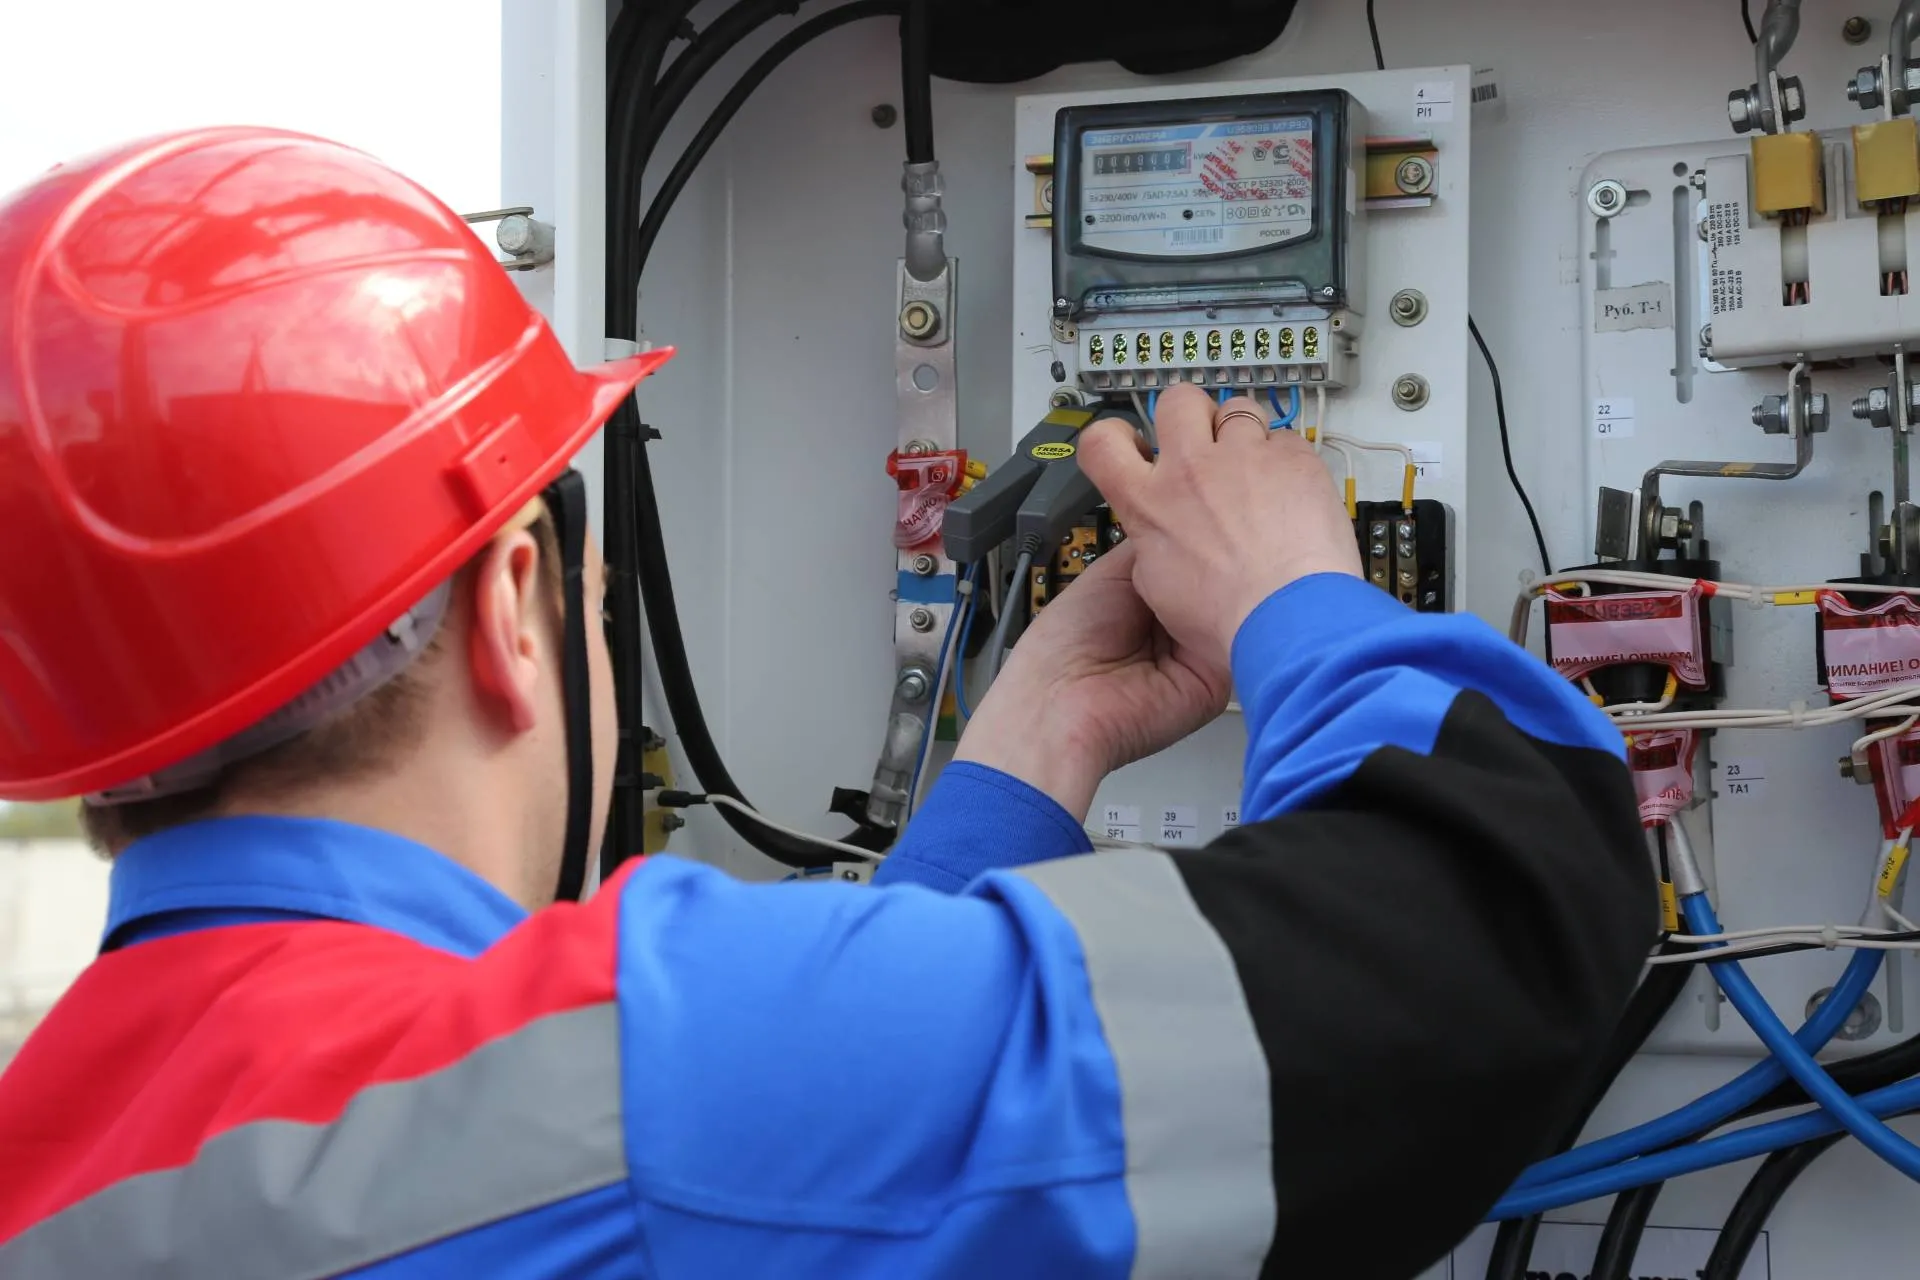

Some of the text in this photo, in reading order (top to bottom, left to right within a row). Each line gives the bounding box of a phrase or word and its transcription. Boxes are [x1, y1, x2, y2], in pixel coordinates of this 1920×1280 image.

[1417, 88, 1424, 98] 4
[1260, 228, 1290, 238] РОССИЯ
[1604, 300, 1662, 320] Руб. Т-1
[1598, 405, 1610, 415] 22
[1598, 424, 1612, 434] Q1
[1727, 765, 1740, 776] 23
[1728, 784, 1749, 794] TA1
[1108, 811, 1118, 820] 11
[1164, 812, 1176, 821] 39
[1226, 812, 1237, 821] 13
[1107, 829, 1124, 838] SF1
[1164, 830, 1182, 839] KV1
